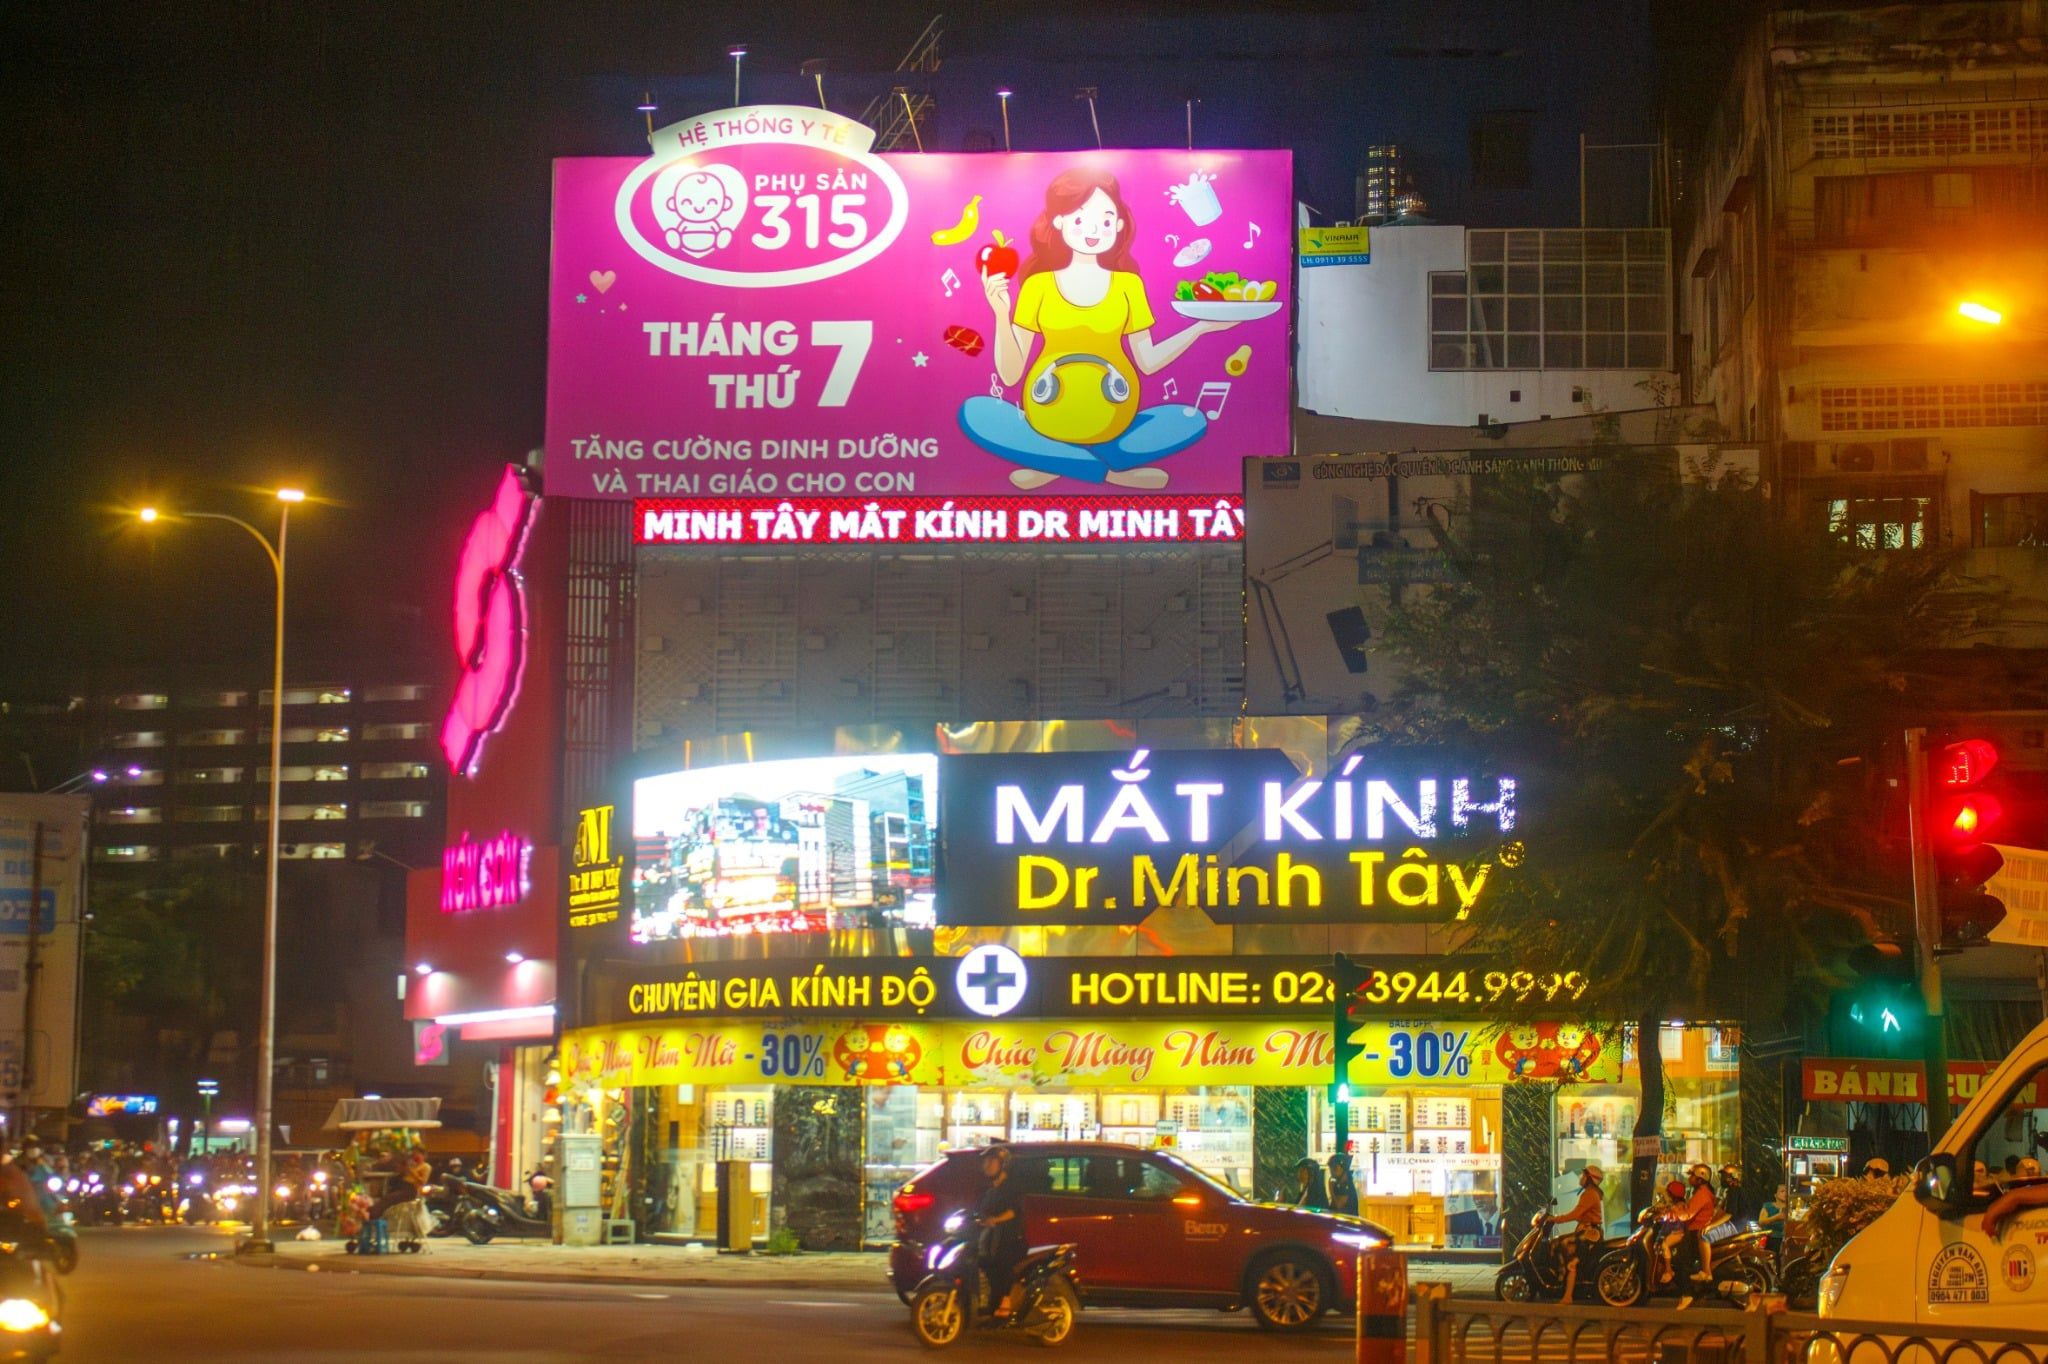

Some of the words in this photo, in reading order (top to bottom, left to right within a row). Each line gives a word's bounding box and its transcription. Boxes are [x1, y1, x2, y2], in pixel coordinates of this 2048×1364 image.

[678, 122, 708, 147] HỆ
[714, 110, 794, 138] THỐNG
[801, 120, 816, 136] Y
[822, 122, 851, 145] TẾ
[755, 173, 806, 195] PHỤ
[816, 168, 867, 191] SẢN
[751, 194, 868, 250] 315
[643, 313, 799, 356] THÁNG
[708, 364, 801, 409] THỨ
[811, 320, 873, 407] 7
[571, 434, 644, 460] TĂNG
[652, 434, 752, 460] CƯỜNG
[761, 439, 828, 459] DINH
[838, 433, 939, 459] DƯỠNG
[593, 468, 628, 494] VÀ
[637, 473, 699, 494] THAI
[709, 468, 778, 494] GIÁO
[786, 472, 847, 493] CHO
[855, 472, 915, 493] CON
[643, 509, 742, 540] MINH
[751, 502, 821, 540] TÂY
[829, 502, 906, 540] MẮT
[914, 501, 1008, 539] KÍNH
[1018, 510, 1071, 538] DR
[1079, 509, 1179, 538] MINH
[995, 750, 1224, 844] MẮT
[1263, 755, 1517, 841] KÍNH
[1018, 854, 1118, 910] Dr.
[1133, 852, 1321, 908] Minh
[1348, 847, 1492, 921] Tây
[628, 970, 717, 1014] CHUYÊN
[724, 976, 780, 1009] GIA
[791, 964, 870, 1008] KÍNH
[881, 966, 936, 1015] ĐỘ
[1071, 972, 1261, 1005] HOTLINE:
[961, 1030, 1037, 1070] Chúc
[1044, 1030, 1154, 1083] Mừng
[1164, 1029, 1257, 1068] Năm
[1813, 1064, 1919, 1097] BÁNH
